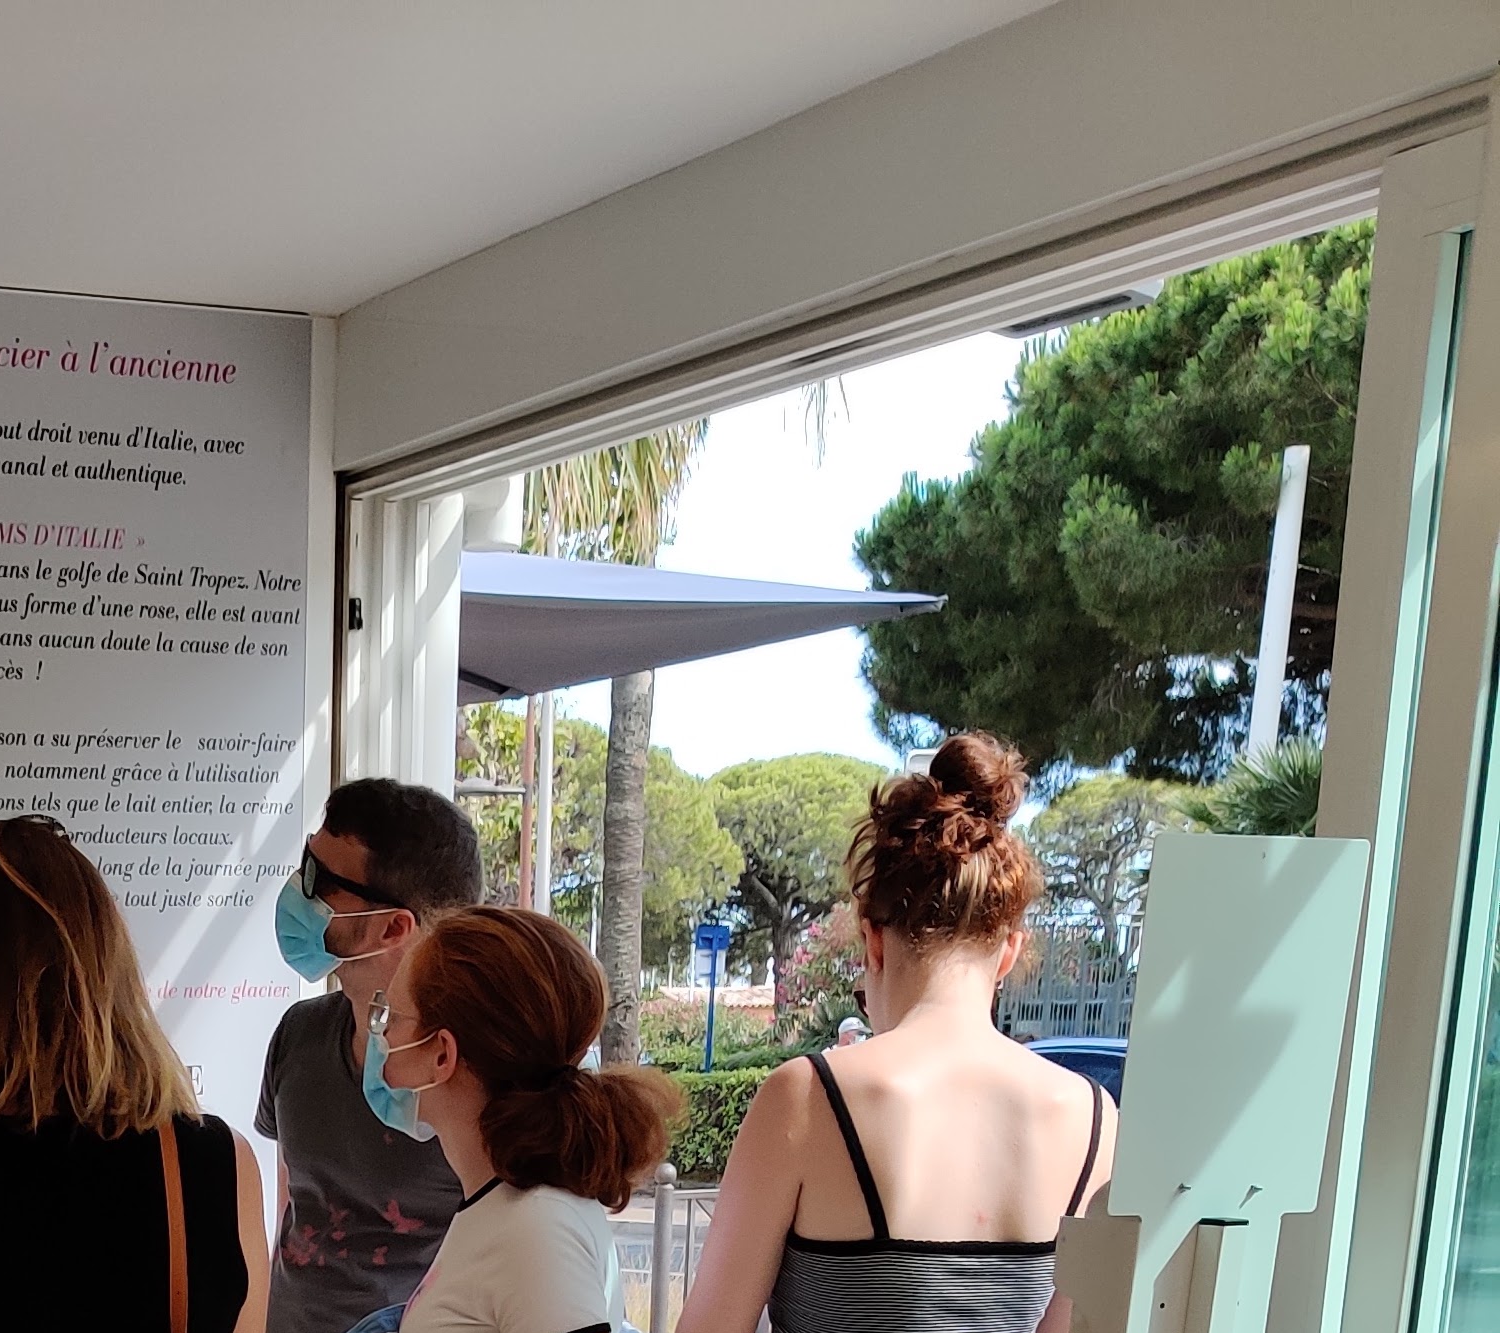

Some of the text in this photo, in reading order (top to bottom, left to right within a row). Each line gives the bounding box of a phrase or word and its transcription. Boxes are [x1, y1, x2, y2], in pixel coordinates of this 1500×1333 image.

[90, 342, 236, 384] l'ancienne
[28, 419, 72, 443] droit
[79, 430, 121, 446] venu
[126, 426, 197, 454] d'Italie,
[204, 439, 245, 455] avec
[75, 459, 186, 491] authentique.
[33, 524, 125, 550] D'ITALIE
[56, 561, 101, 589] golfe
[107, 562, 129, 584] de
[134, 563, 183, 586] Saint
[190, 566, 249, 595] Tropez.
[254, 570, 301, 592] Notre
[20, 592, 77, 620] forme
[83, 595, 133, 618] d'une
[139, 605, 179, 621] rose,
[186, 600, 216, 621] elle
[222, 605, 245, 622] est
[251, 608, 300, 625] avant
[39, 634, 94, 649] aucun
[101, 629, 150, 651] doute
[180, 640, 229, 654] cause
[261, 643, 287, 656] son
[74, 728, 160, 754] préserver
[198, 732, 296, 758] savoir-faire
[5, 762, 106, 780] notamment
[111, 763, 162, 787] grâce
[186, 761, 278, 783] l'utilisation
[32, 791, 61, 811] tels
[67, 799, 98, 818] que
[126, 793, 156, 812] lait
[162, 795, 212, 815] entier,
[243, 796, 294, 815] crème
[173, 825, 233, 845] locaux.
[98, 856, 296, 883] long journée pour
[125, 891, 156, 906] tout
[159, 889, 201, 913] juste
[208, 889, 254, 907] sortie
[183, 983, 227, 999] notre
